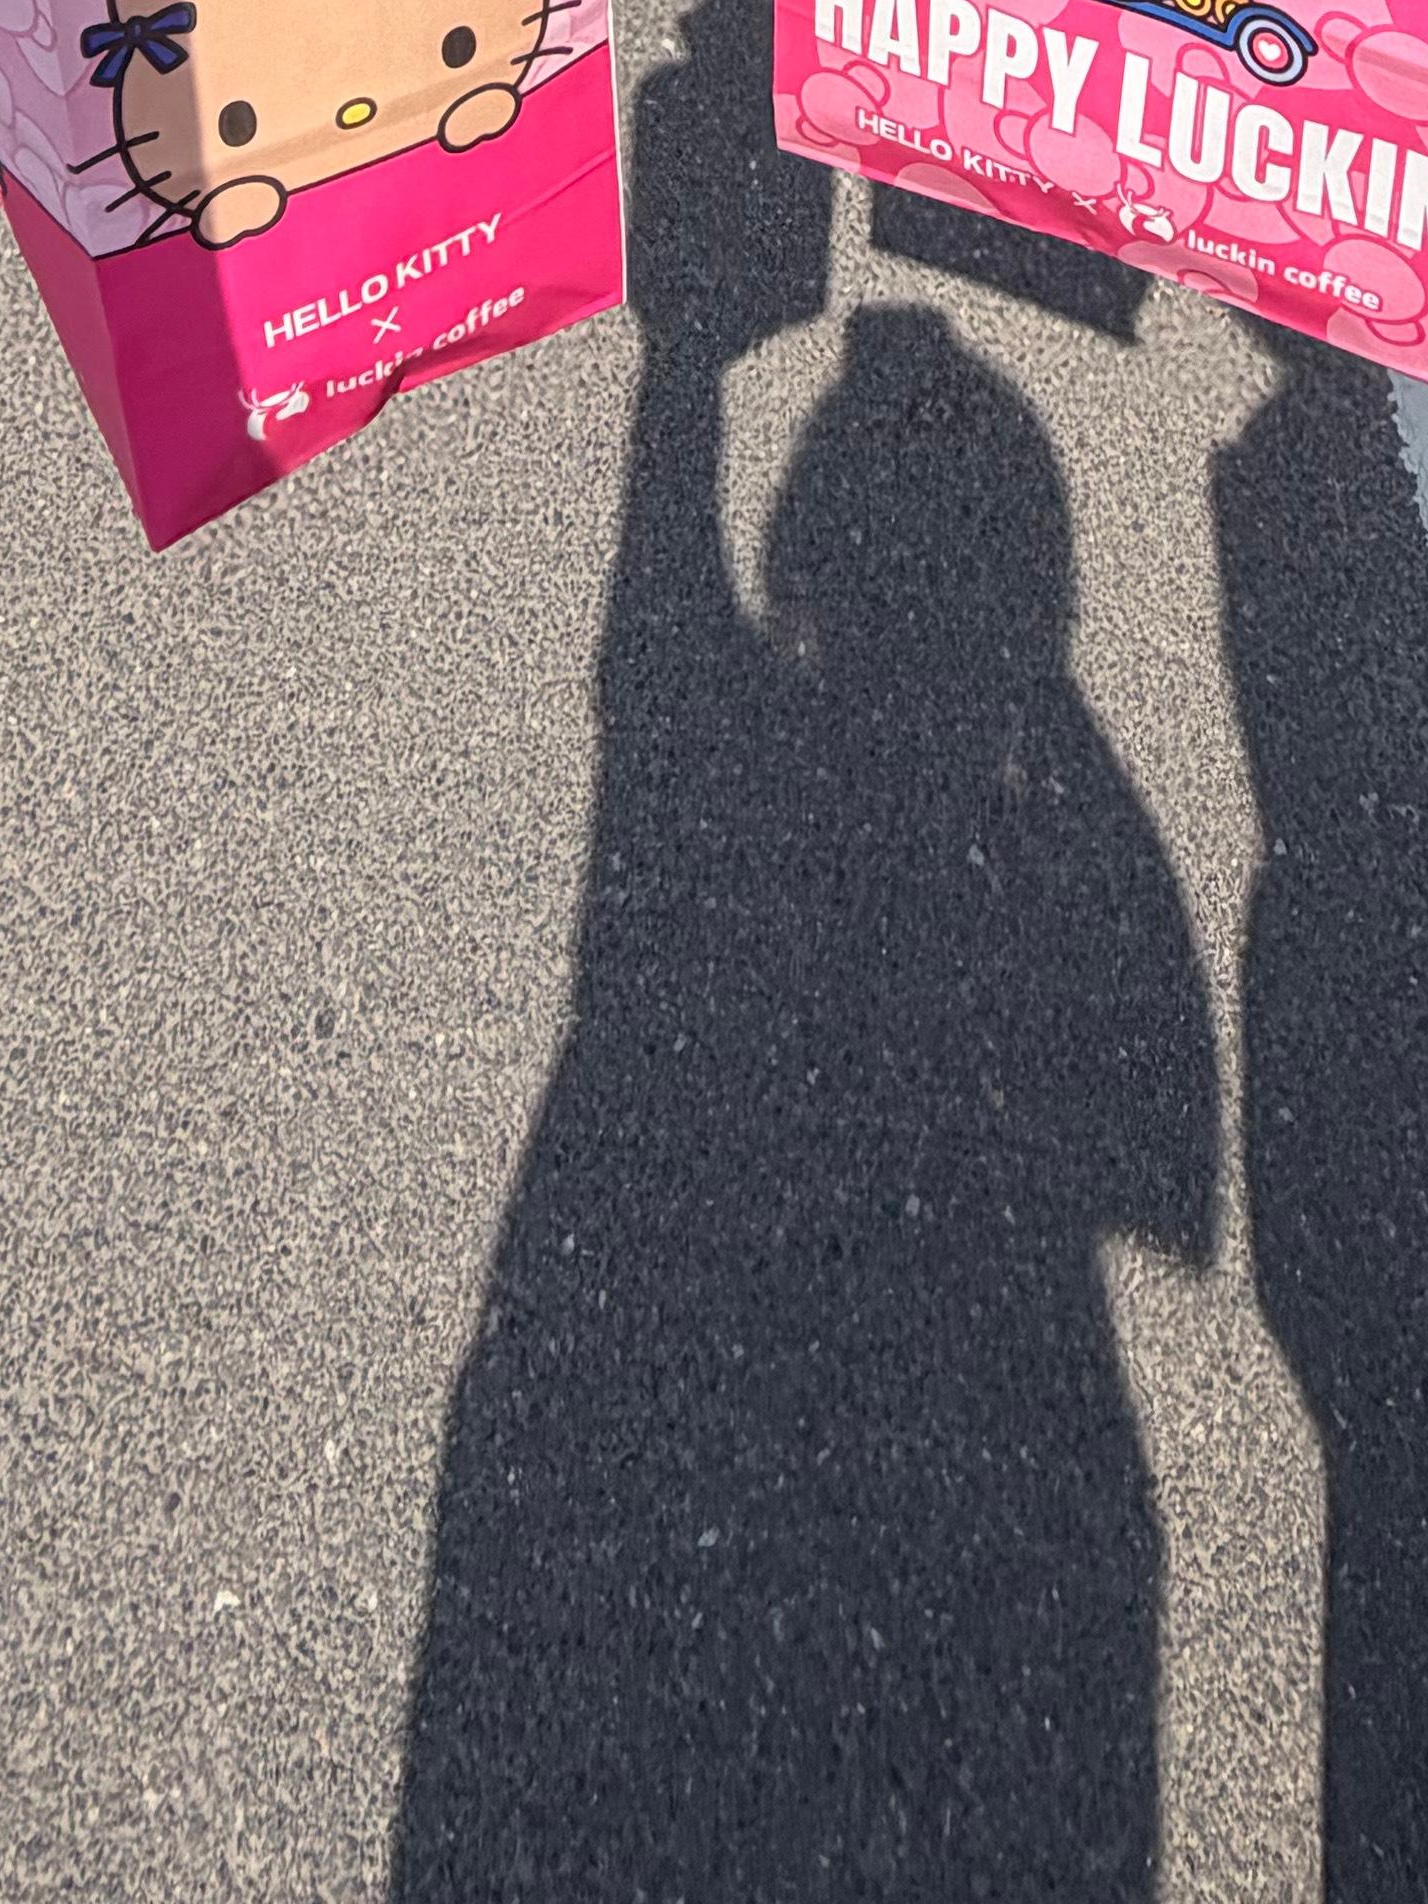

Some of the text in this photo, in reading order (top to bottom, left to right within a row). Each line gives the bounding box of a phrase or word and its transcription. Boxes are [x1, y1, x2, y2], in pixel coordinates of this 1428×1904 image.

[857, 107, 953, 162] HELLO
[962, 147, 1056, 196] KITTY
[1187, 228, 1277, 278] luckin
[1283, 263, 1383, 313] coffee
[263, 212, 503, 348] HELLO KITTY
[431, 286, 526, 353] coffee
